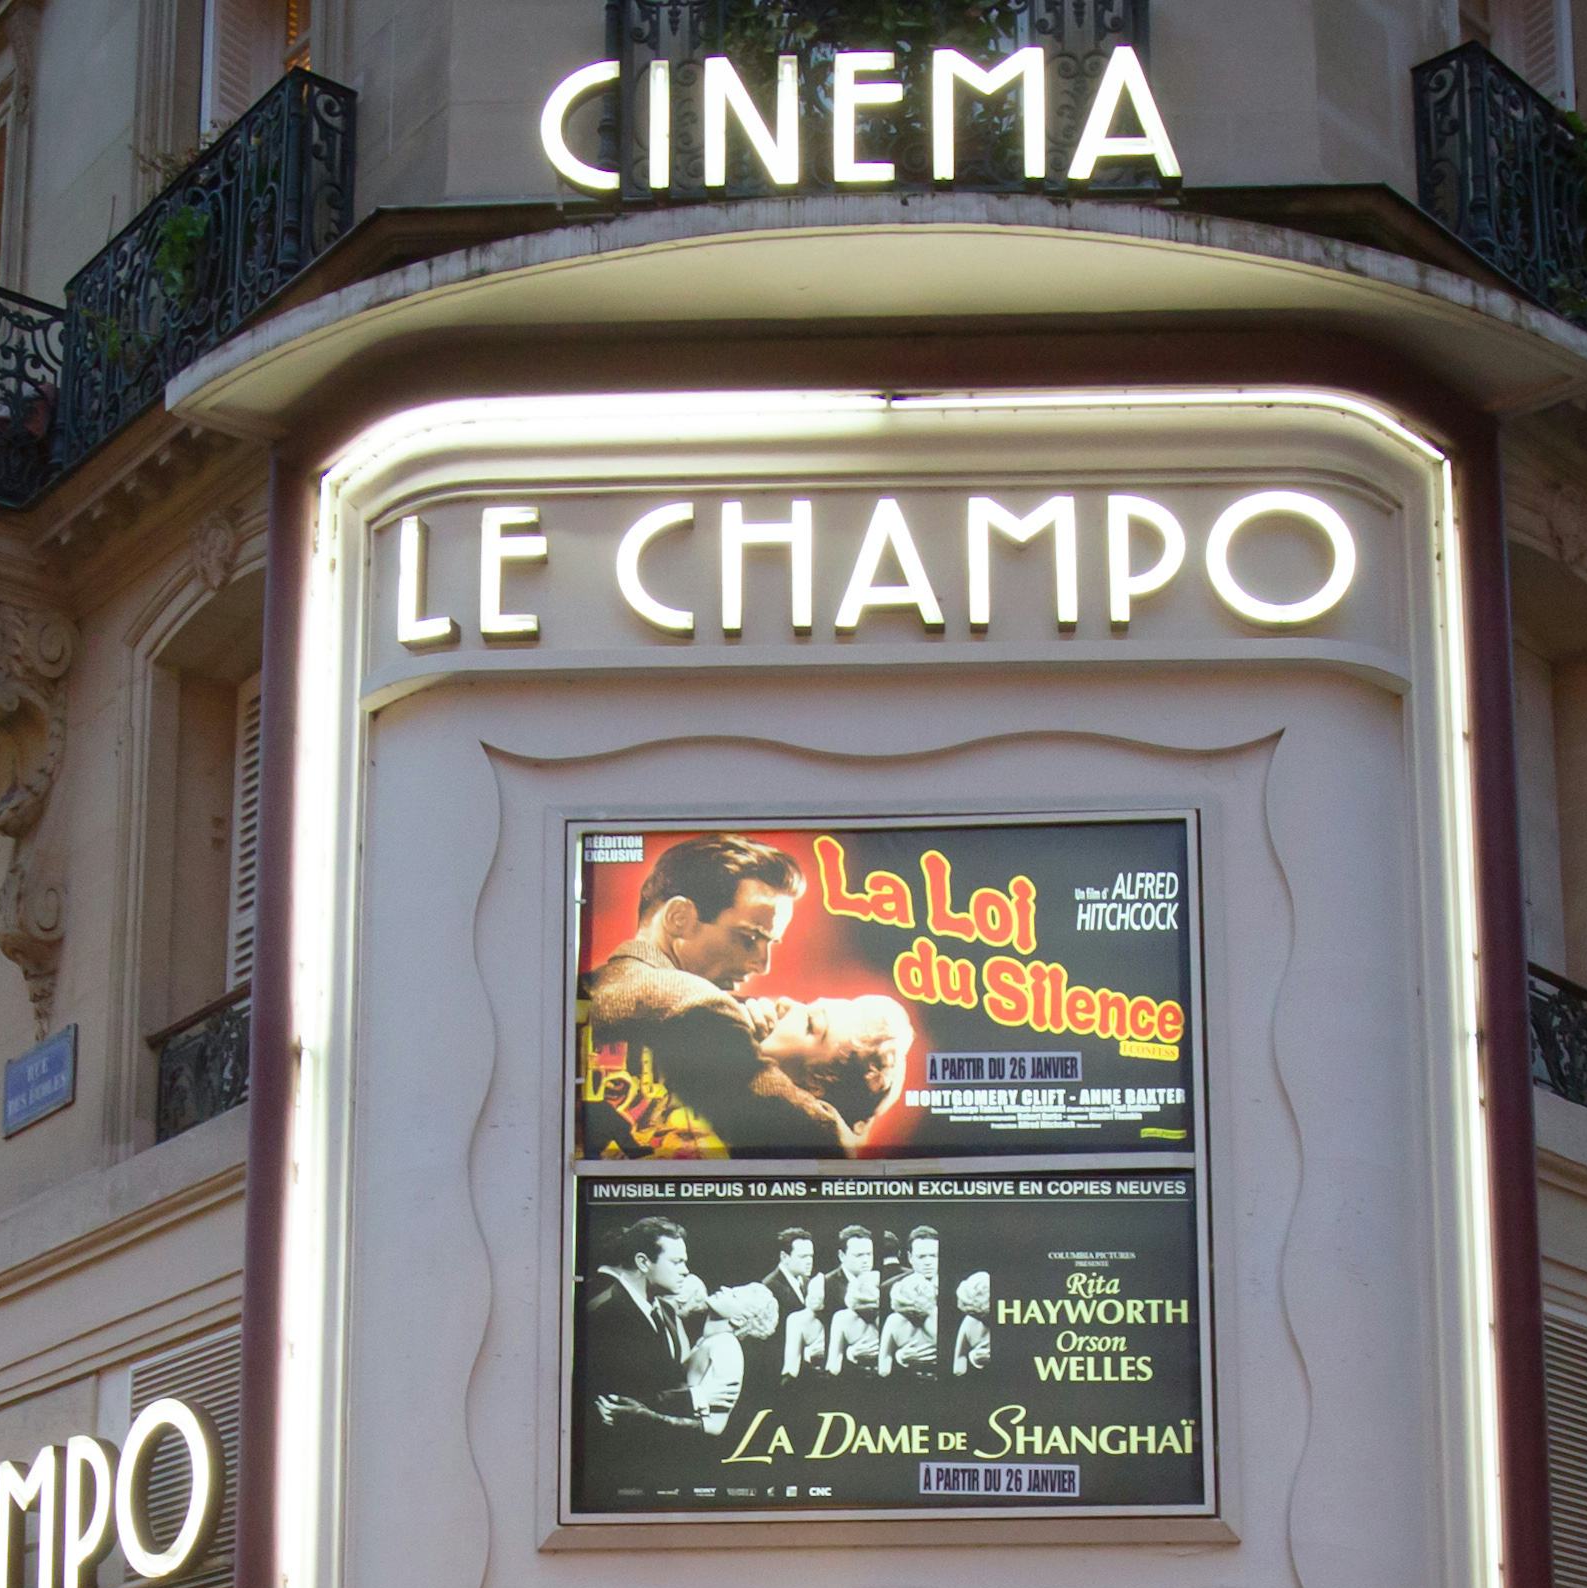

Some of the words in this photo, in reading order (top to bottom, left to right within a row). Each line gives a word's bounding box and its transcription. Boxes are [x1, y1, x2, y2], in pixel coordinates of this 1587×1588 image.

[540, 46, 1182, 190] CINEMA
[397, 506, 549, 642] LE
[615, 491, 1356, 635] CHAMPO
[584, 849, 644, 862] EXCLUSIVE
[814, 835, 915, 929] La
[920, 850, 1037, 955] Loi
[1112, 872, 1179, 900] ALFRED
[1076, 902, 1179, 931] HITCHCOCK
[893, 937, 977, 1009] du
[982, 956, 1185, 1044] Silence
[929, 1055, 938, 1080] À
[942, 1057, 985, 1080] PARTIR
[989, 1057, 1005, 1079] DU
[1012, 1056, 1026, 1079] 26
[1030, 1056, 1079, 1079] JANVIER
[905, 1089, 1019, 1107] MONTGOMERY
[1021, 1089, 1066, 1106] CLIFT
[1079, 1088, 1122, 1105] ANNE
[1125, 1088, 1186, 1105] BAXTER
[593, 1183, 675, 1198] INVISIBLE
[680, 1182, 743, 1198] DEPUIS
[748, 1182, 767, 1197] 10
[771, 1182, 807, 1196] ANS
[822, 1178, 913, 1196] RÉÉDITION
[919, 1181, 1014, 1196] EXCLUSIVE
[1019, 1181, 1042, 1195] EN
[1047, 1180, 1112, 1195] COPIES
[1116, 1179, 1187, 1195] NEUVES
[1048, 1252, 1094, 1260] COLUMBIA
[1066, 1272, 1121, 1299] Rita
[997, 1299, 1189, 1324] HAYWORTH
[1056, 1330, 1128, 1352] Orson
[1034, 1355, 1154, 1382] WELLES
[805, 1411, 930, 1459] DAME
[938, 1432, 968, 1451] DE
[809, 1487, 832, 1497] CNC
[923, 1465, 932, 1491] À
[935, 1467, 979, 1492] PARTIR
[985, 1467, 1001, 1492] DU
[1006, 1468, 1022, 1492] 26
[1027, 1468, 1076, 1493] JANVIER
